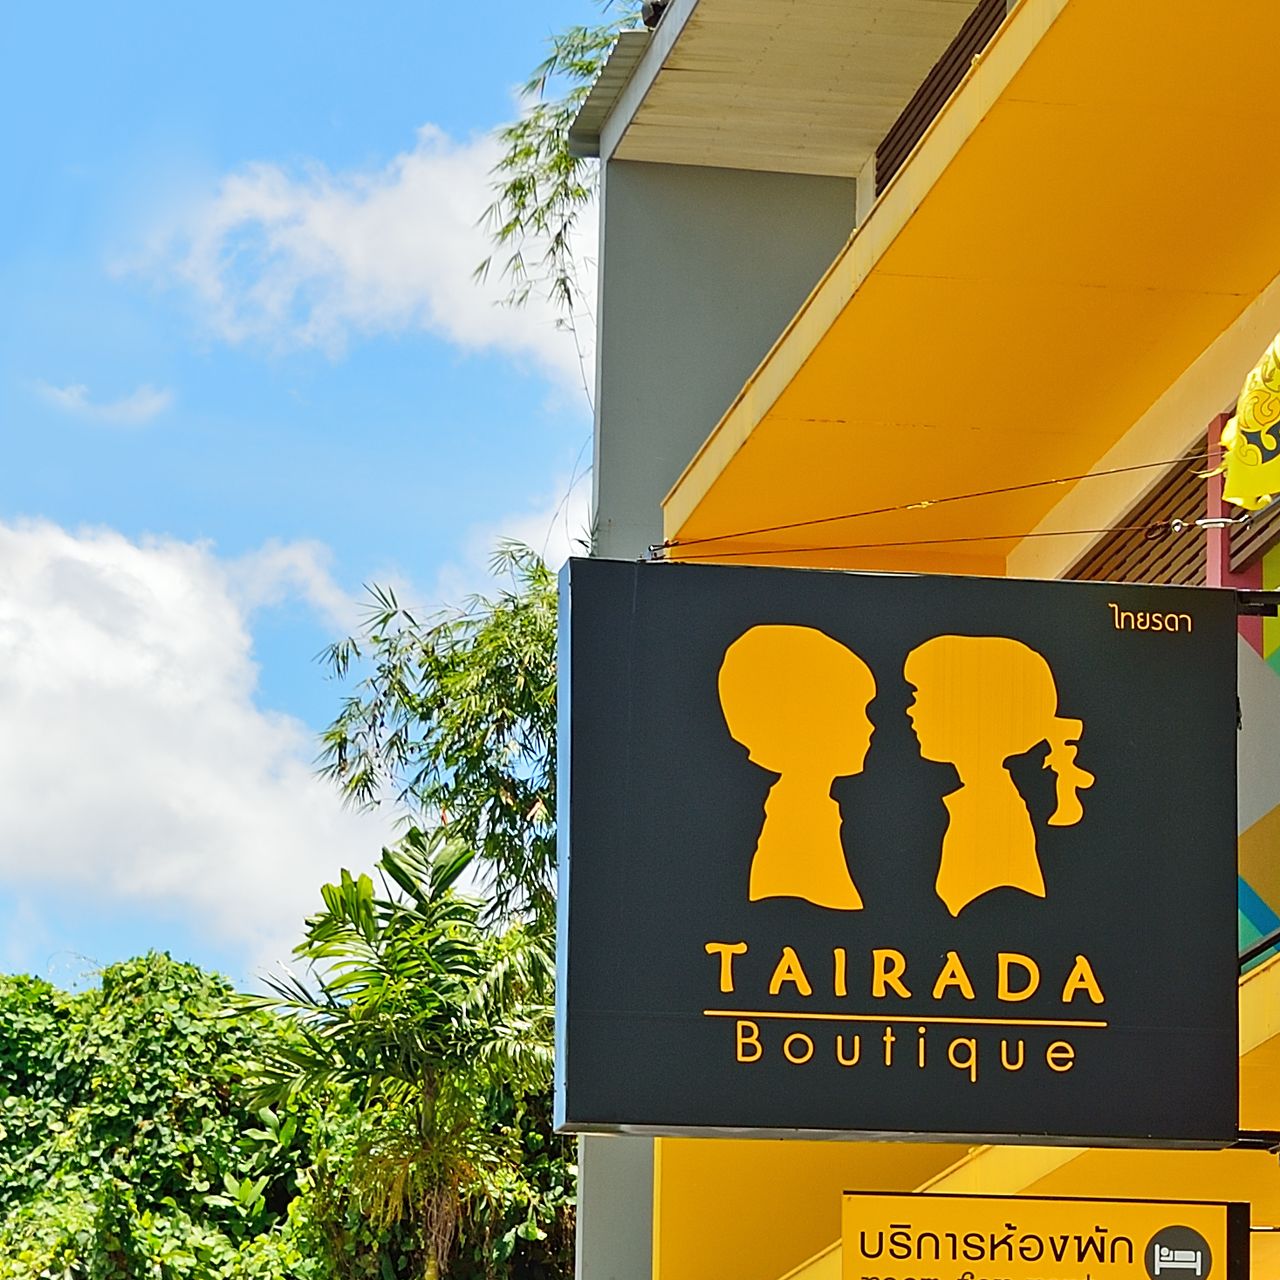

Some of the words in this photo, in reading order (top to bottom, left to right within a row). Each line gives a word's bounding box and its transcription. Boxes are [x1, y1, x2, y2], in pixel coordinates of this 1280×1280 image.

[1108, 603, 1192, 632] ไทยรดา
[705, 942, 1105, 1004] TAIRADA
[736, 1020, 1076, 1082] Boutique
[860, 1223, 1134, 1264] บริการห้องพัก
